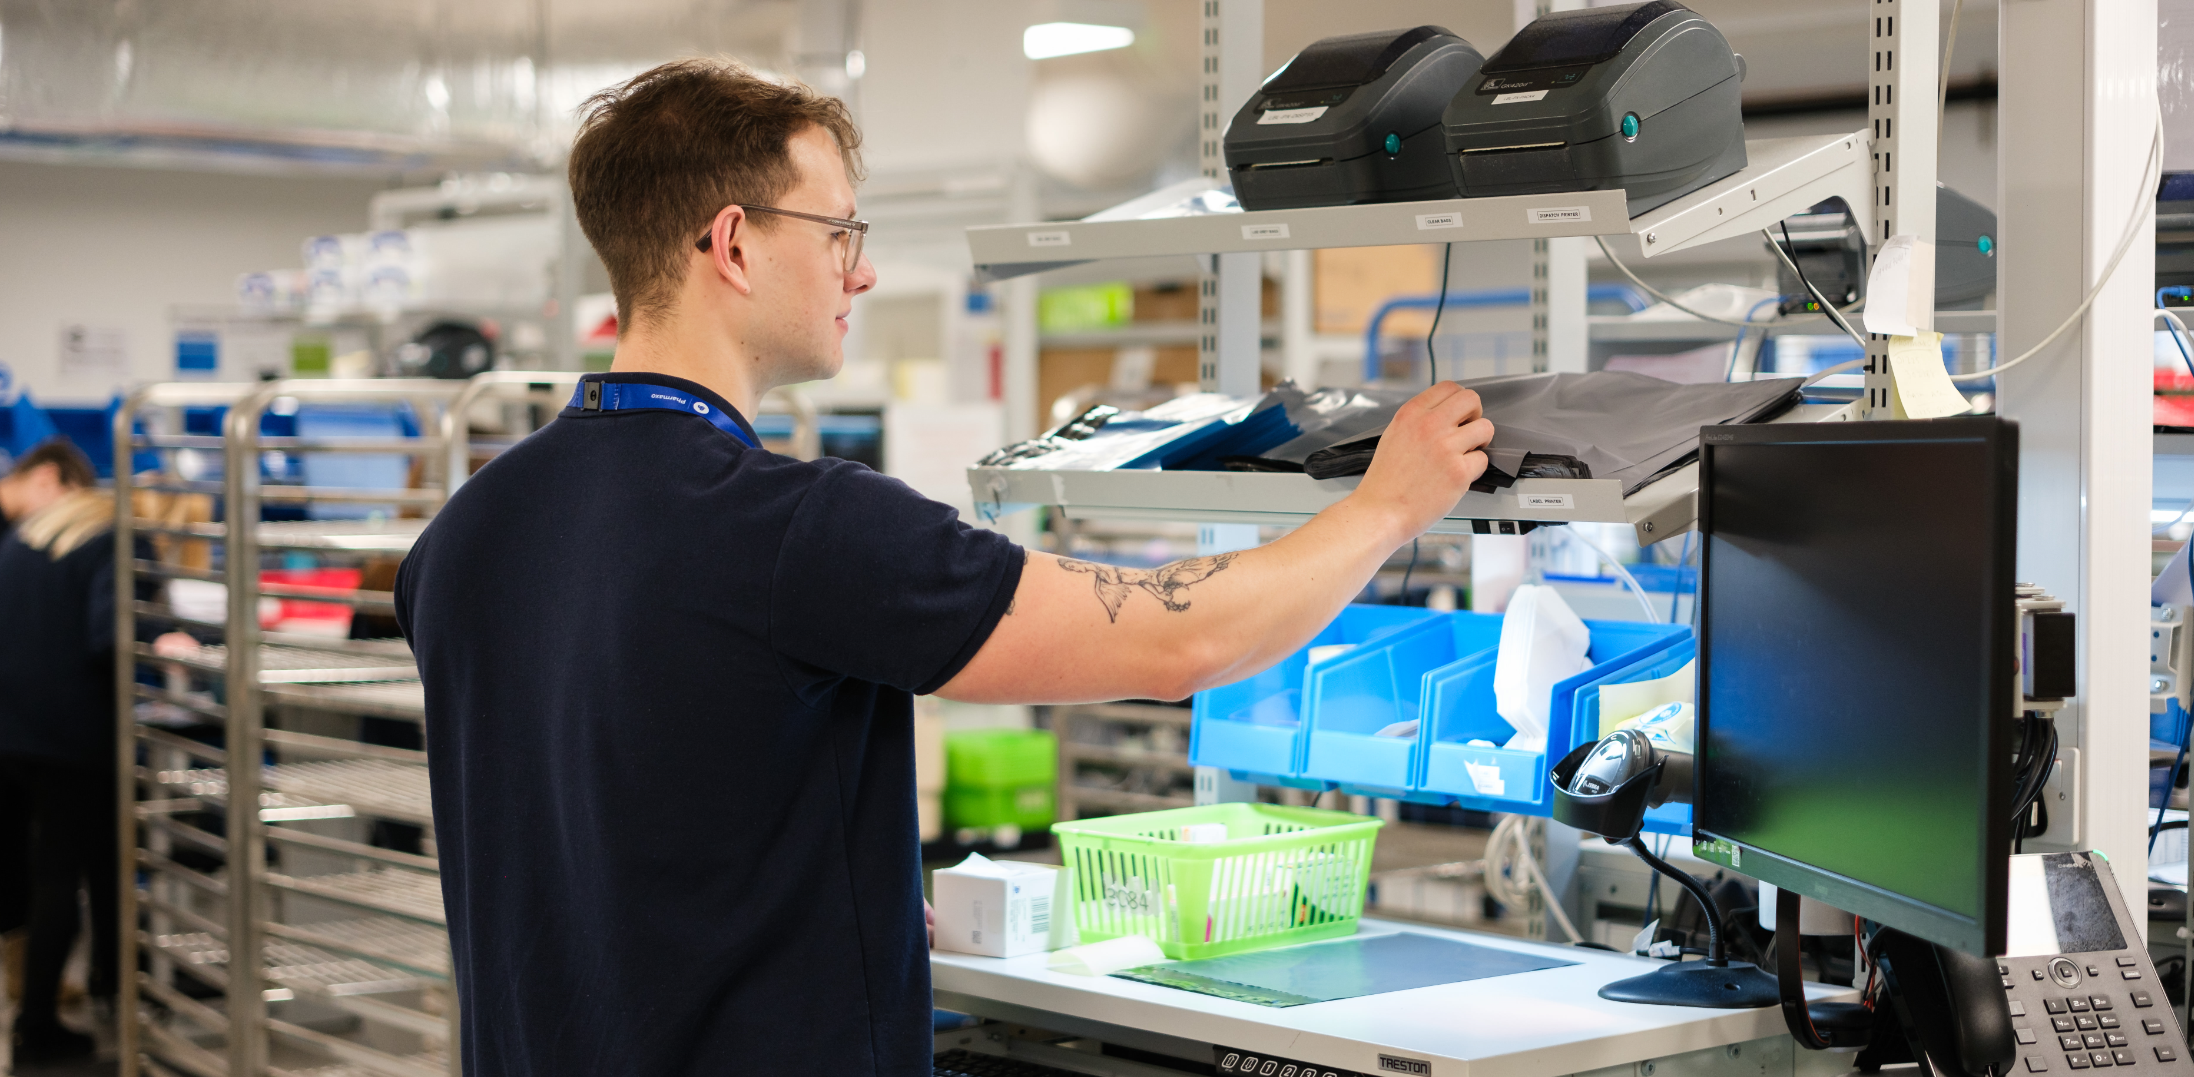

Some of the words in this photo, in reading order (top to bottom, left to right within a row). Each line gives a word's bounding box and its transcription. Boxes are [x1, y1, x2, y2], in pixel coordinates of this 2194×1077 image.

[651, 393, 687, 405] Pharmaxo
[1380, 1056, 1428, 1074] TRESTON
[1283, 1067, 1293, 1077] 2
